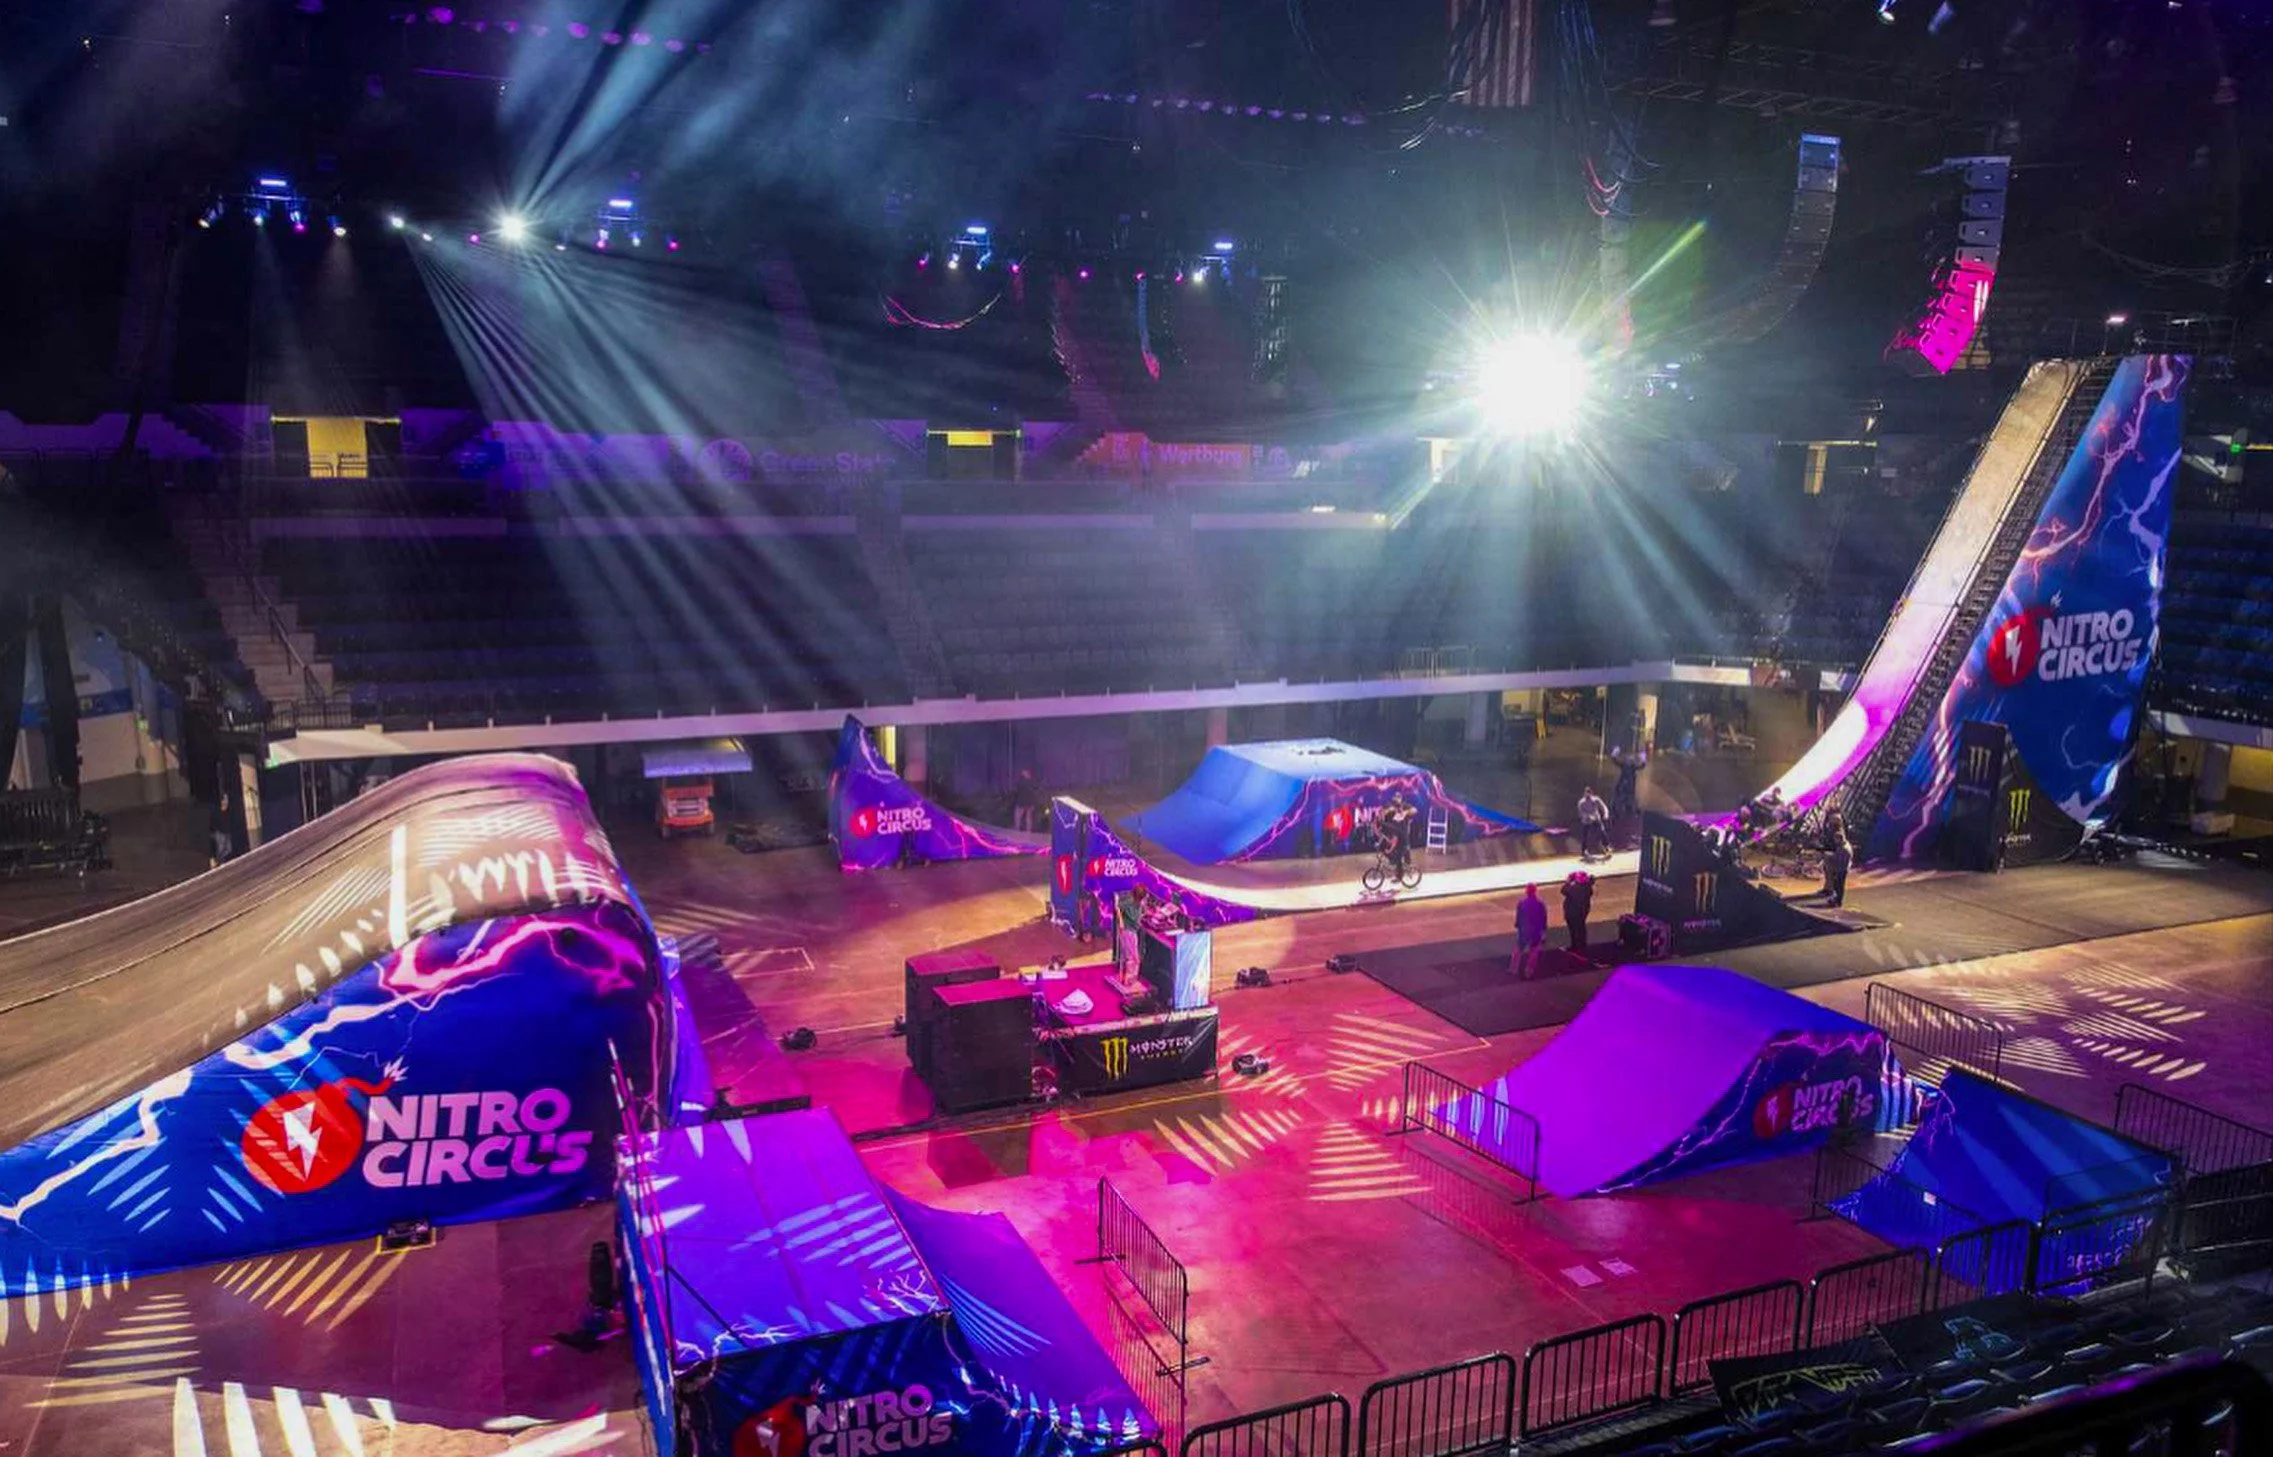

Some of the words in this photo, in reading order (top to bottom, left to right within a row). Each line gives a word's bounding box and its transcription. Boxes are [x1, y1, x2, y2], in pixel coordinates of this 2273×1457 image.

[2040, 609, 2134, 648] NITRO
[2038, 638, 2142, 682] CIRCUS
[877, 807, 925, 822] NITRO
[877, 818, 932, 835] CIRCUS
[1130, 1036, 1193, 1054] MONSTER
[366, 1088, 571, 1142] NITRO
[362, 1131, 593, 1188] CIRCUS
[806, 1384, 934, 1435] NITRO
[809, 1411, 953, 1457] CIRCUS
